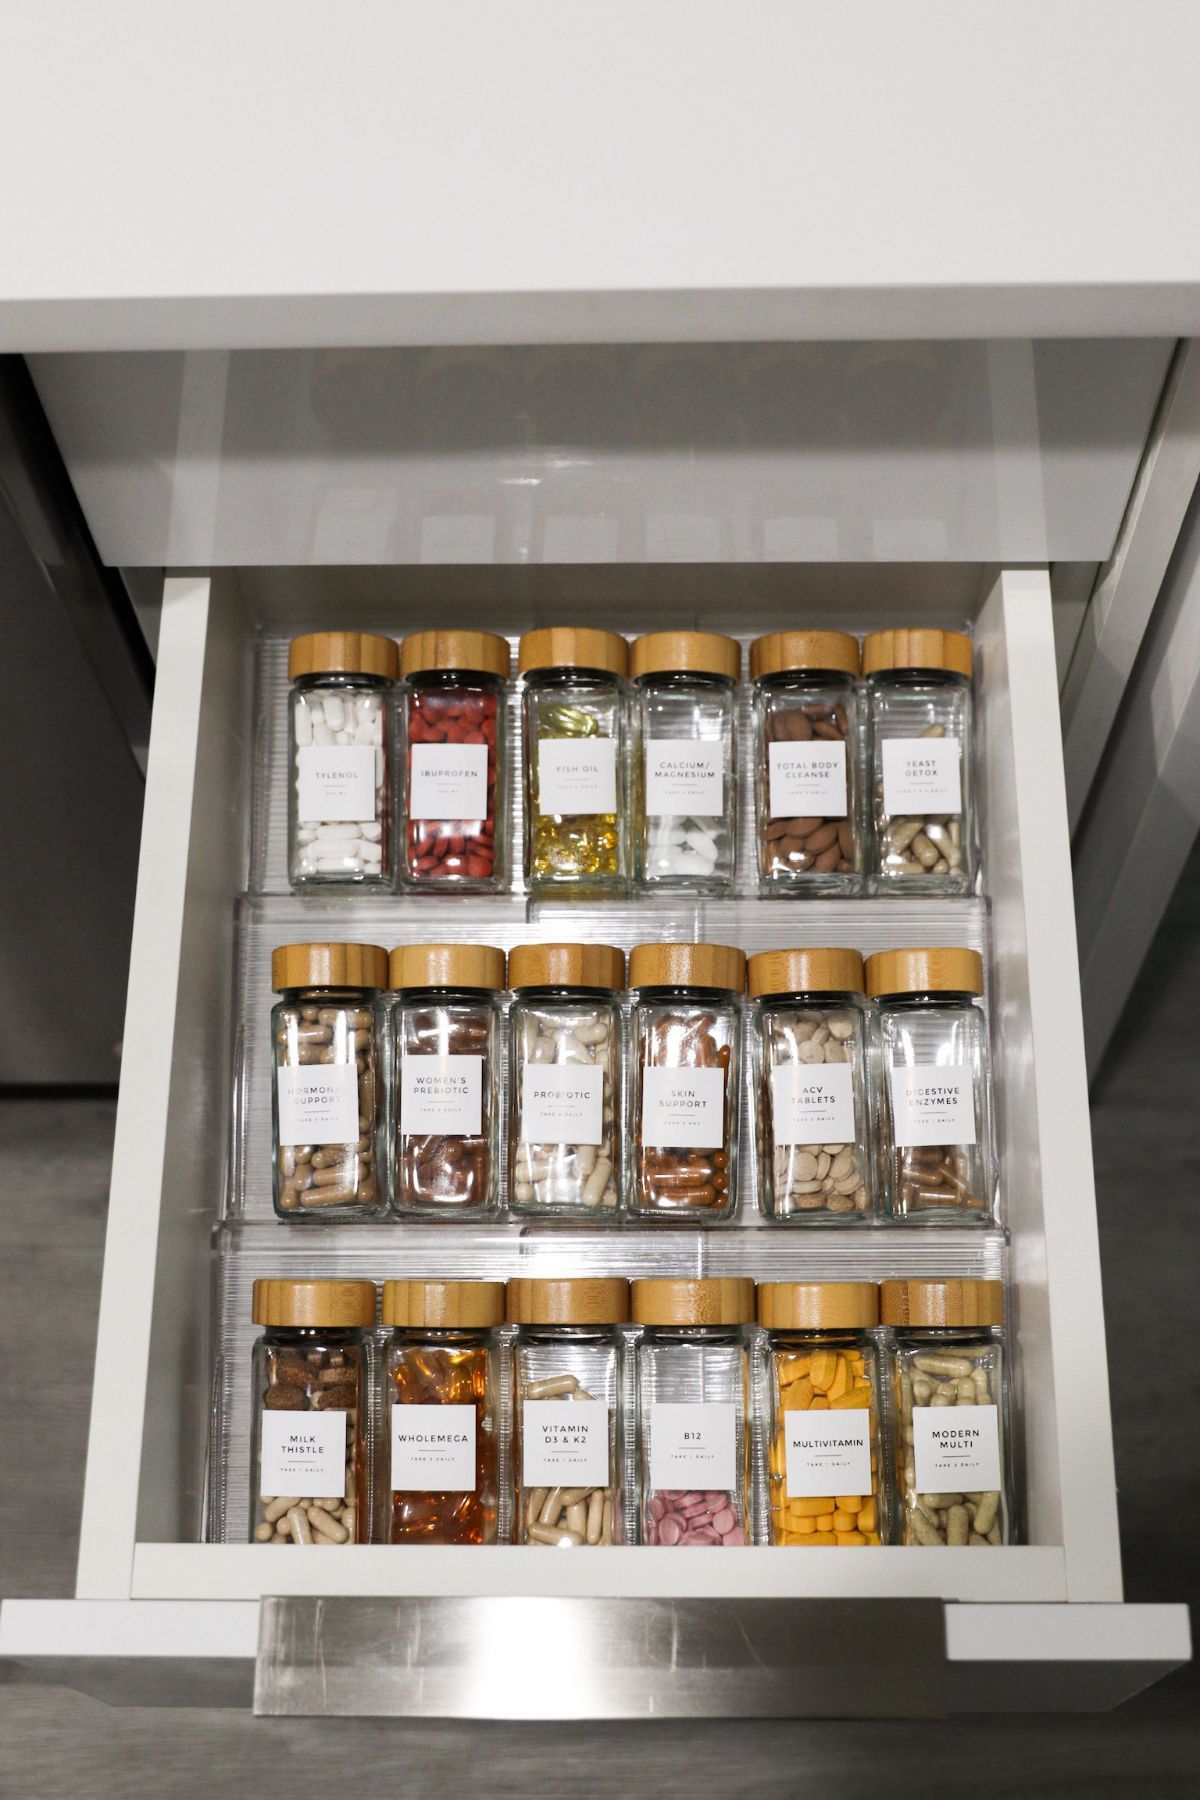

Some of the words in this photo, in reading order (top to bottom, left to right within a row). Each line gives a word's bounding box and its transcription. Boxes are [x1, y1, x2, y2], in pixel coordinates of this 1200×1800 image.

[659, 761, 711, 770] CALCIUM/
[777, 762, 808, 771] TOTAL
[811, 761, 838, 769] BODY
[905, 759, 937, 768] YEAST
[420, 769, 478, 778] IBUPROFEN
[556, 765, 579, 774] FISH
[582, 764, 600, 773] OIL
[904, 769, 938, 778] DETOX
[315, 771, 358, 780] TYLENOL
[654, 771, 716, 779] MAGNESIUM
[784, 771, 831, 780] CLEANSE
[416, 1076, 468, 1085] WOMEN'S
[287, 1086, 345, 1096] HORMON
[413, 1086, 470, 1095] PREBIOTIC
[671, 1089, 696, 1098] SKIN
[801, 1085, 824, 1095] ACV
[905, 1086, 961, 1097] DIGESTIVE
[294, 1095, 341, 1106] SUPPORT
[658, 1099, 707, 1109] SUPPORT
[790, 1095, 837, 1105] TABLETS
[908, 1096, 959, 1107] ENZYMES
[541, 1424, 590, 1434] VITAMIN
[289, 1434, 317, 1444] MILK
[397, 1433, 470, 1443] WHOLEMEGA
[683, 1431, 703, 1441] B12
[931, 1429, 981, 1440] MODERN
[544, 1435, 559, 1445] D3
[561, 1435, 570, 1445] &
[573, 1435, 588, 1445] K2
[791, 1438, 865, 1449] MULTIVITAMIN
[939, 1440, 974, 1450] MULTI
[280, 1444, 325, 1455] THISTLE
